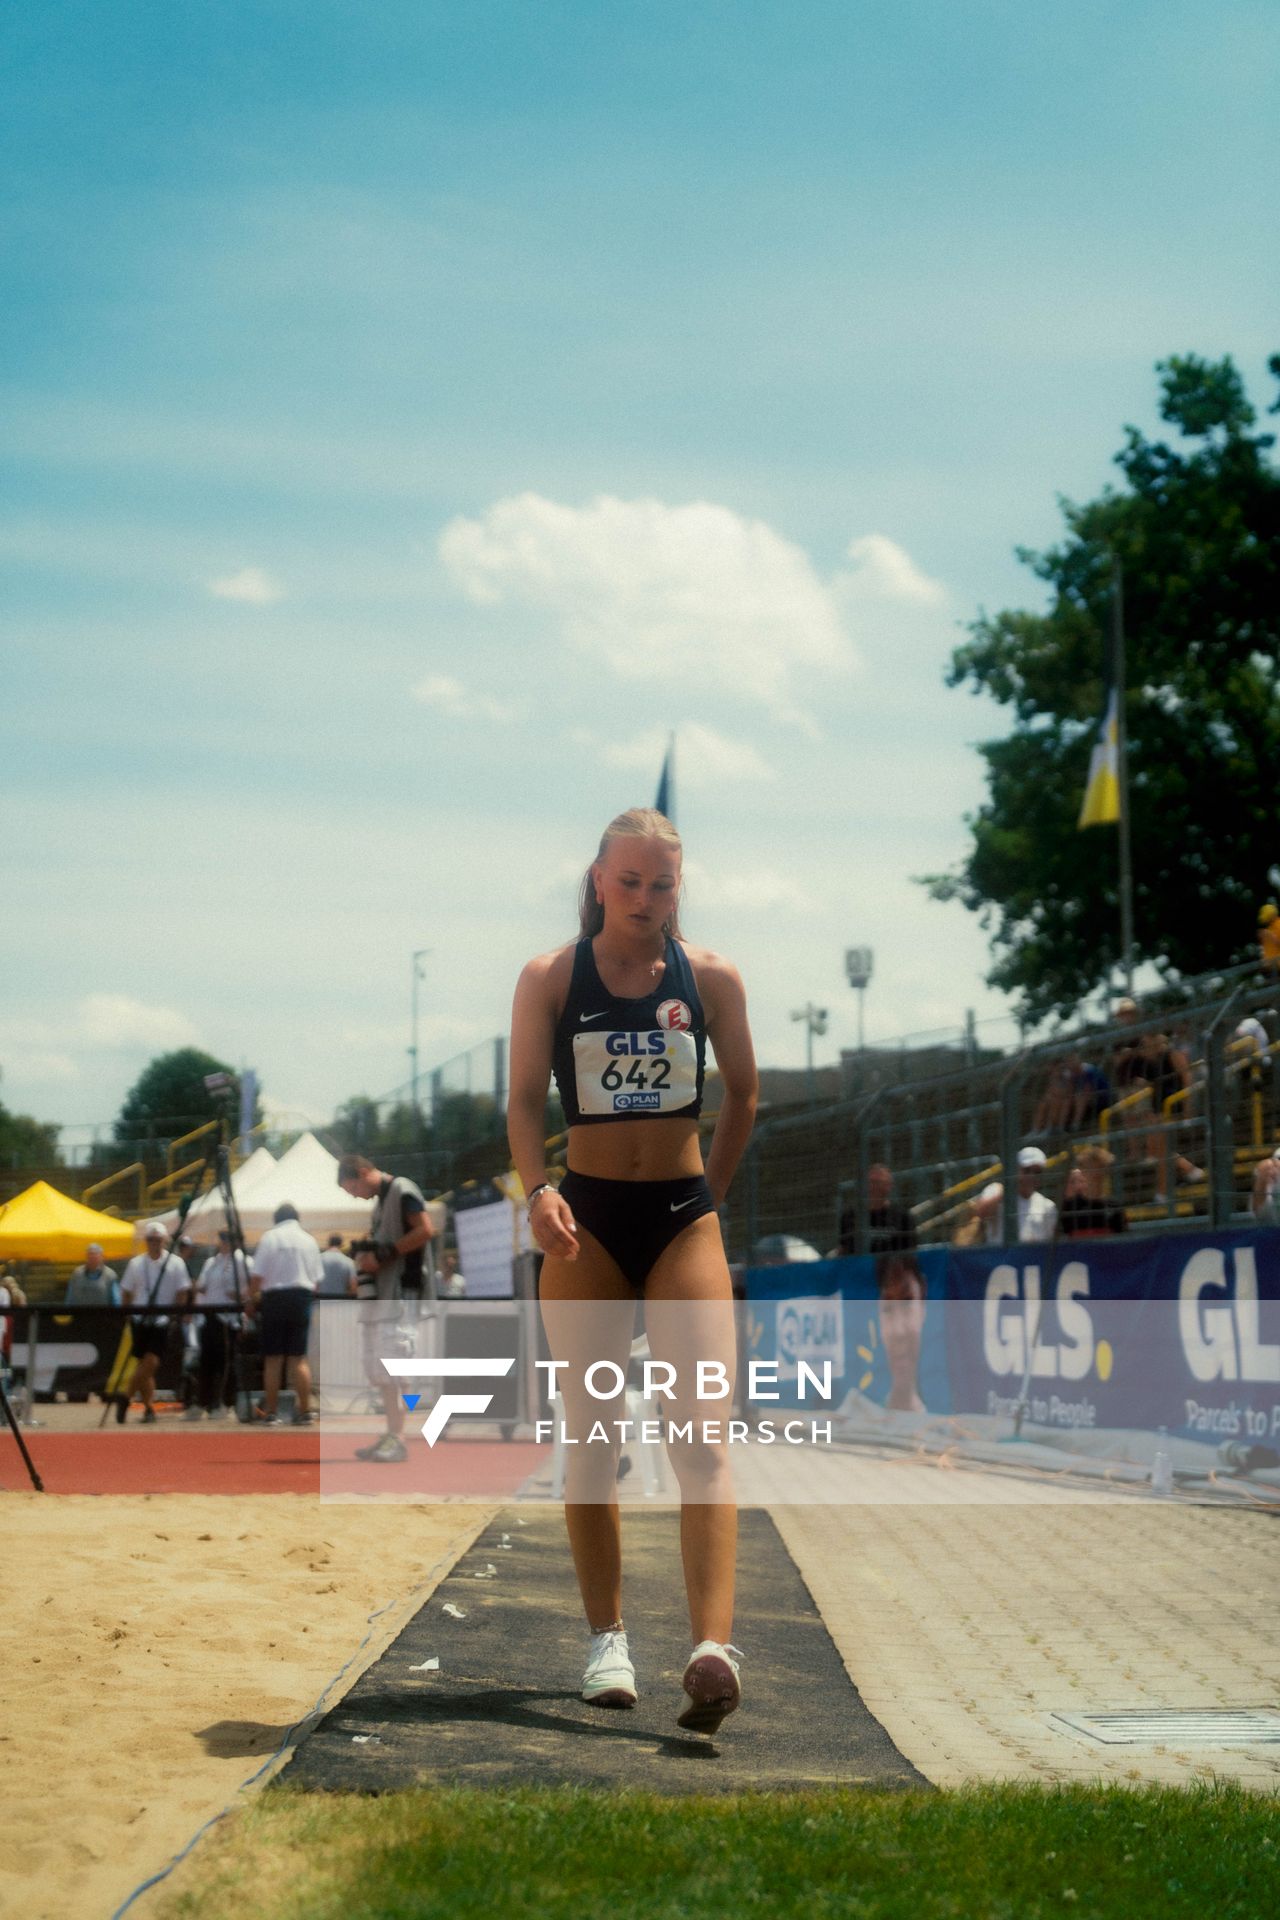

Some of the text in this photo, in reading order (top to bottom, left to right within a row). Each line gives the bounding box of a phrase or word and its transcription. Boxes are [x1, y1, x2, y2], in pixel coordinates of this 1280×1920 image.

[601, 1059, 671, 1091] 642
[632, 1095, 658, 1104] PLAN
[1032, 1396, 1048, 1421] to
[1050, 1395, 1096, 1430] People
[1184, 1399, 1240, 1433] Parcels
[1244, 1405, 1268, 1437] to
